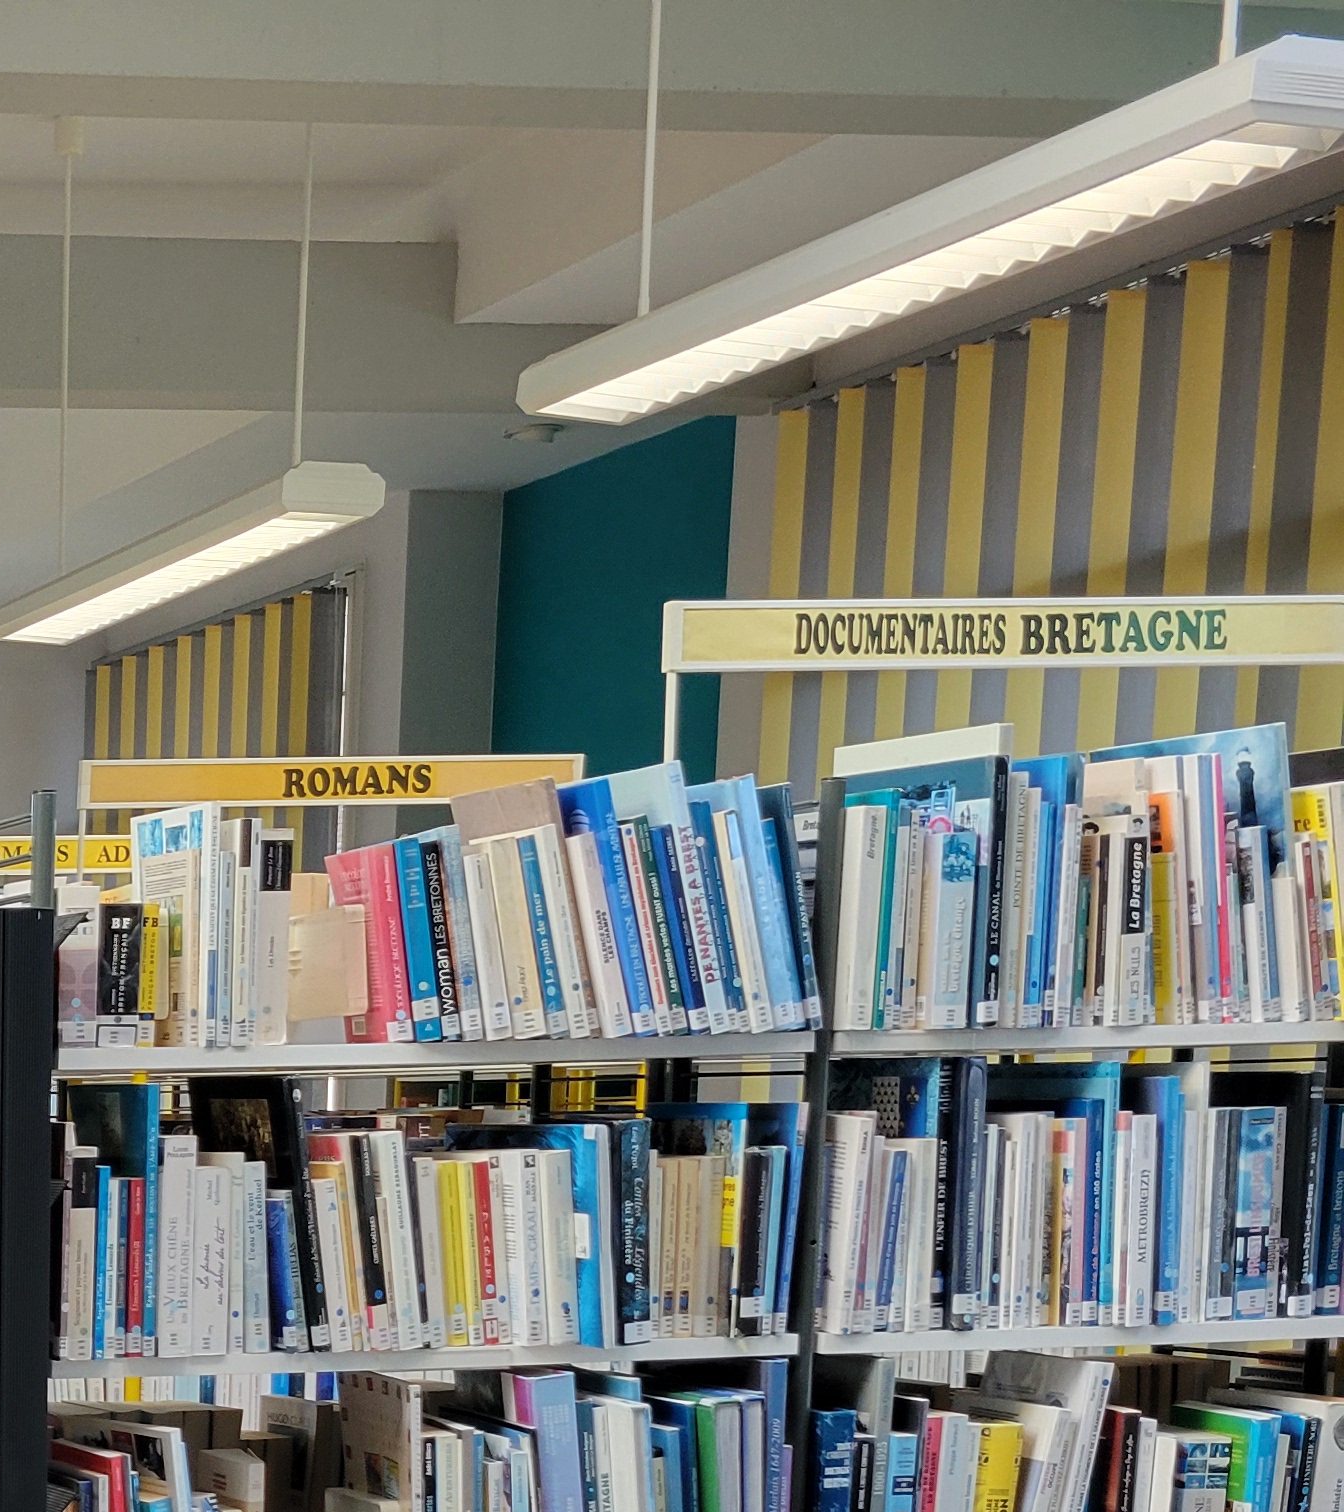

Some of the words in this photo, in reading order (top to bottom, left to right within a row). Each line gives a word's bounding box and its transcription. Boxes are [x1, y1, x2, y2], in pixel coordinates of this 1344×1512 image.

[793, 612, 1007, 656] DOCUMENTAIRES
[1019, 608, 1228, 656] BRETAGNE
[281, 764, 432, 798] ROMANS
[1015, 781, 1027, 844] BRETAGNE
[97, 844, 131, 863] AD
[678, 826, 696, 873] BREST
[1014, 847, 1025, 862] DE
[426, 852, 443, 922] BRETONNES
[650, 879, 661, 897] aussi
[795, 871, 805, 902] PAGAN
[1012, 867, 1024, 908] POINTE
[1129, 842, 1144, 908] Bretagne
[533, 892, 546, 916] mer
[654, 899, 665, 922] TUENT
[798, 905, 808, 928] PAYS
[991, 891, 1001, 929] CANAL
[111, 917, 131, 930] BF
[536, 919, 548, 935] de
[596, 909, 605, 931] DANS
[601, 911, 612, 941] CHAMPS
[689, 896, 710, 958] NANTES
[1129, 910, 1141, 929] La
[433, 924, 445, 945] LES
[658, 923, 670, 948] vertes
[801, 931, 810, 942] LE
[990, 931, 1000, 945] LE
[539, 939, 552, 965] pain
[599, 934, 610, 964] SILENCE
[605, 944, 614, 959] LES
[1130, 947, 1141, 976] NULS
[543, 968, 555, 984] Le
[662, 950, 675, 977] marées
[704, 962, 716, 984] DE
[436, 949, 454, 1014] woman
[668, 979, 678, 992] Les
[938, 1139, 948, 1178] BREST
[1093, 1151, 1101, 1178] dates
[254, 1179, 263, 1216] Kerhuel
[937, 1182, 947, 1199] DE
[1093, 1180, 1101, 1195] 100
[1331, 1171, 1344, 1210] bretons
[246, 1192, 256, 1213] vent
[624, 1199, 634, 1216] du
[1093, 1197, 1100, 1209] en
[246, 1225, 256, 1234] et
[254, 1219, 263, 1230] de
[525, 1206, 538, 1251] GRAAL
[935, 1202, 946, 1251] L'ENFER
[1331, 1213, 1343, 1221] et
[164, 1217, 178, 1259] CHÊNE
[246, 1237, 256, 1261] L'eau
[1328, 1224, 1342, 1270] Bretagne
[163, 1264, 177, 1307] VIEUX
[178, 1239, 190, 1309] BRETAGNE
[252, 1293, 260, 1319] Thomas
[770, 1418, 782, 1472] 1647-2009
[445, 1443, 454, 1503] AVENTURIERS
[872, 1441, 888, 1496] 1900-1925
